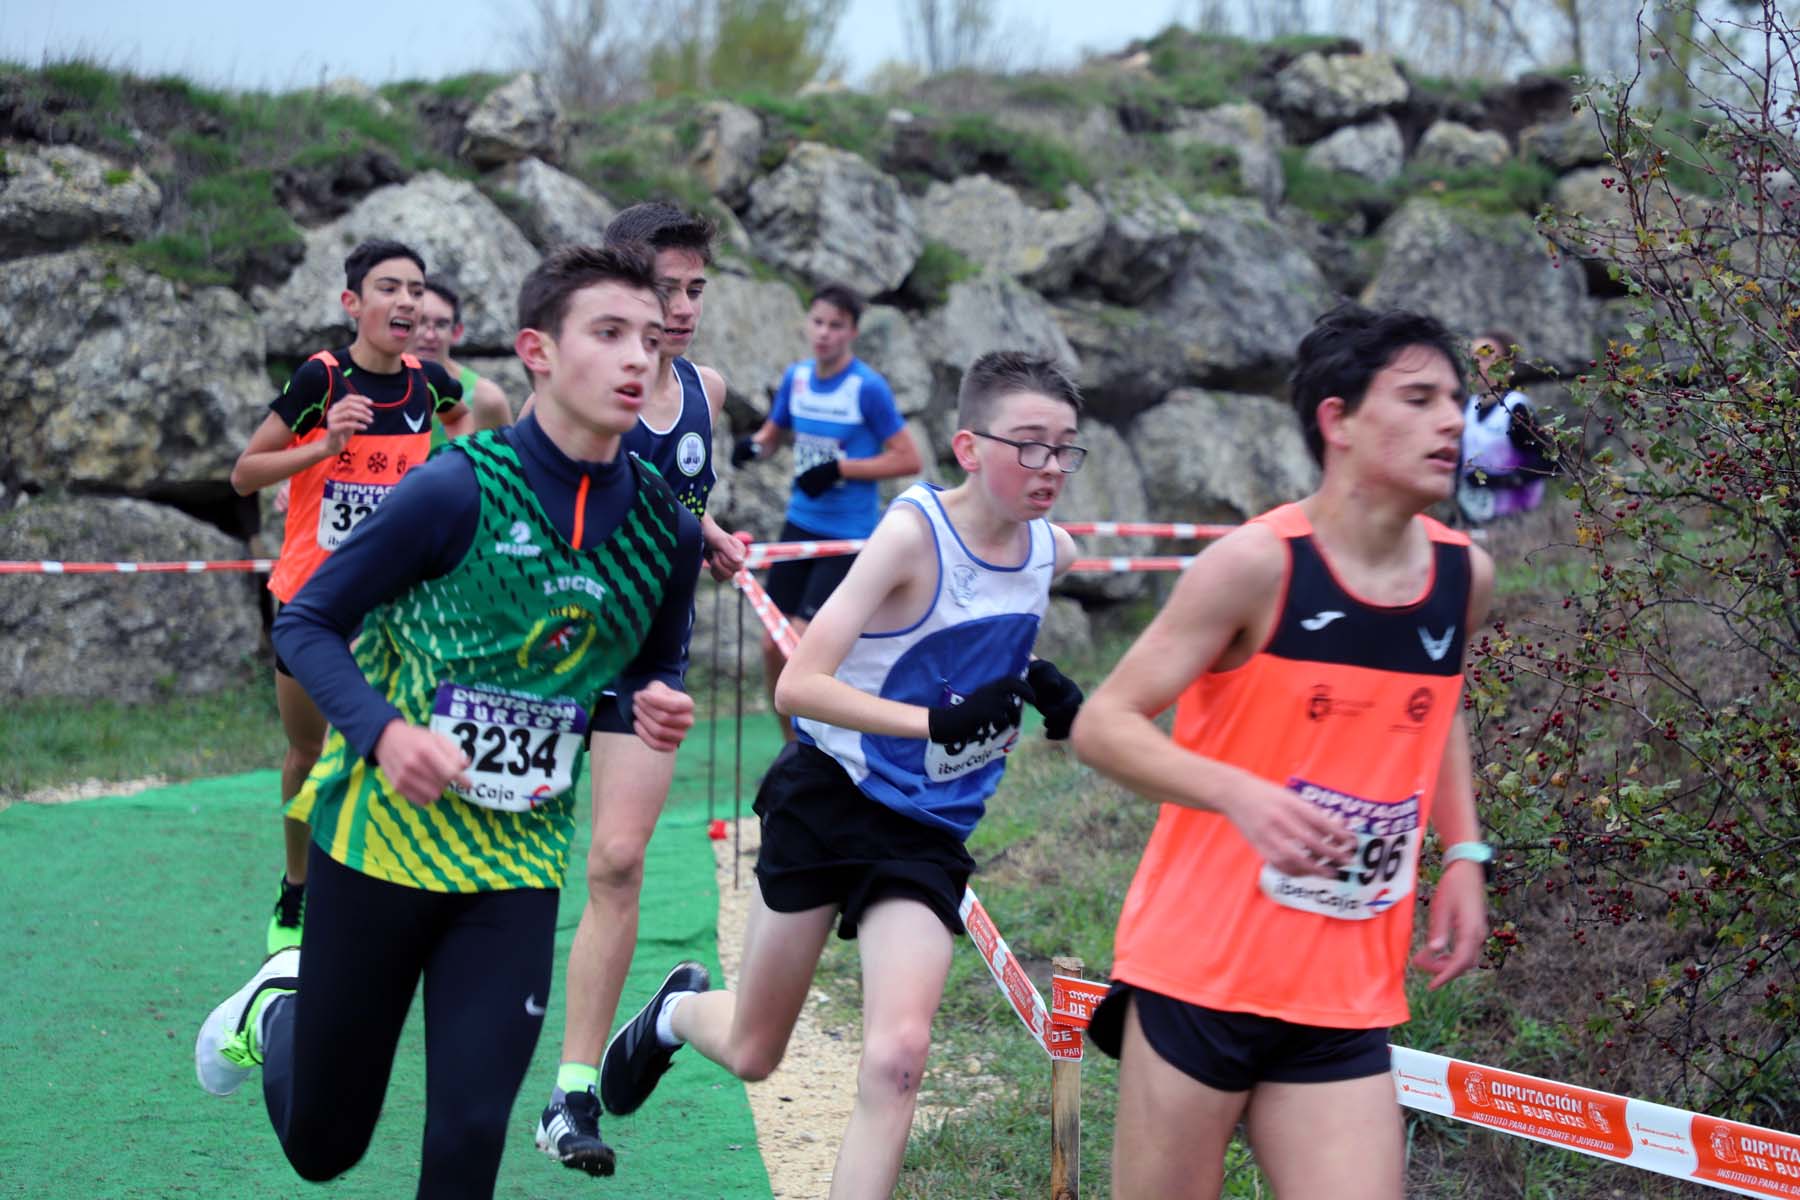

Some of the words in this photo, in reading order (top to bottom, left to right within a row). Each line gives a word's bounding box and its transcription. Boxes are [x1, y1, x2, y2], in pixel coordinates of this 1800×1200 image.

[450, 702, 574, 732] BURGOS
[452, 722, 561, 778] 3234
[1069, 1002, 1086, 1017] DE
[1052, 1031, 1072, 1042] DE
[1491, 1081, 1582, 1114] DIPUTACIÓN
[1494, 1099, 1517, 1114] DE
[1522, 1104, 1587, 1129] BURGOS
[1472, 1112, 1508, 1127] INSTITUTO
[1509, 1118, 1527, 1131] PARA
[1538, 1125, 1569, 1141] DEPORTE
[1576, 1135, 1614, 1151] JUVENTUD
[1744, 1154, 1770, 1172] DE
[1717, 1168, 1757, 1185] INSTITUTO
[1759, 1177, 1778, 1191] PARA
